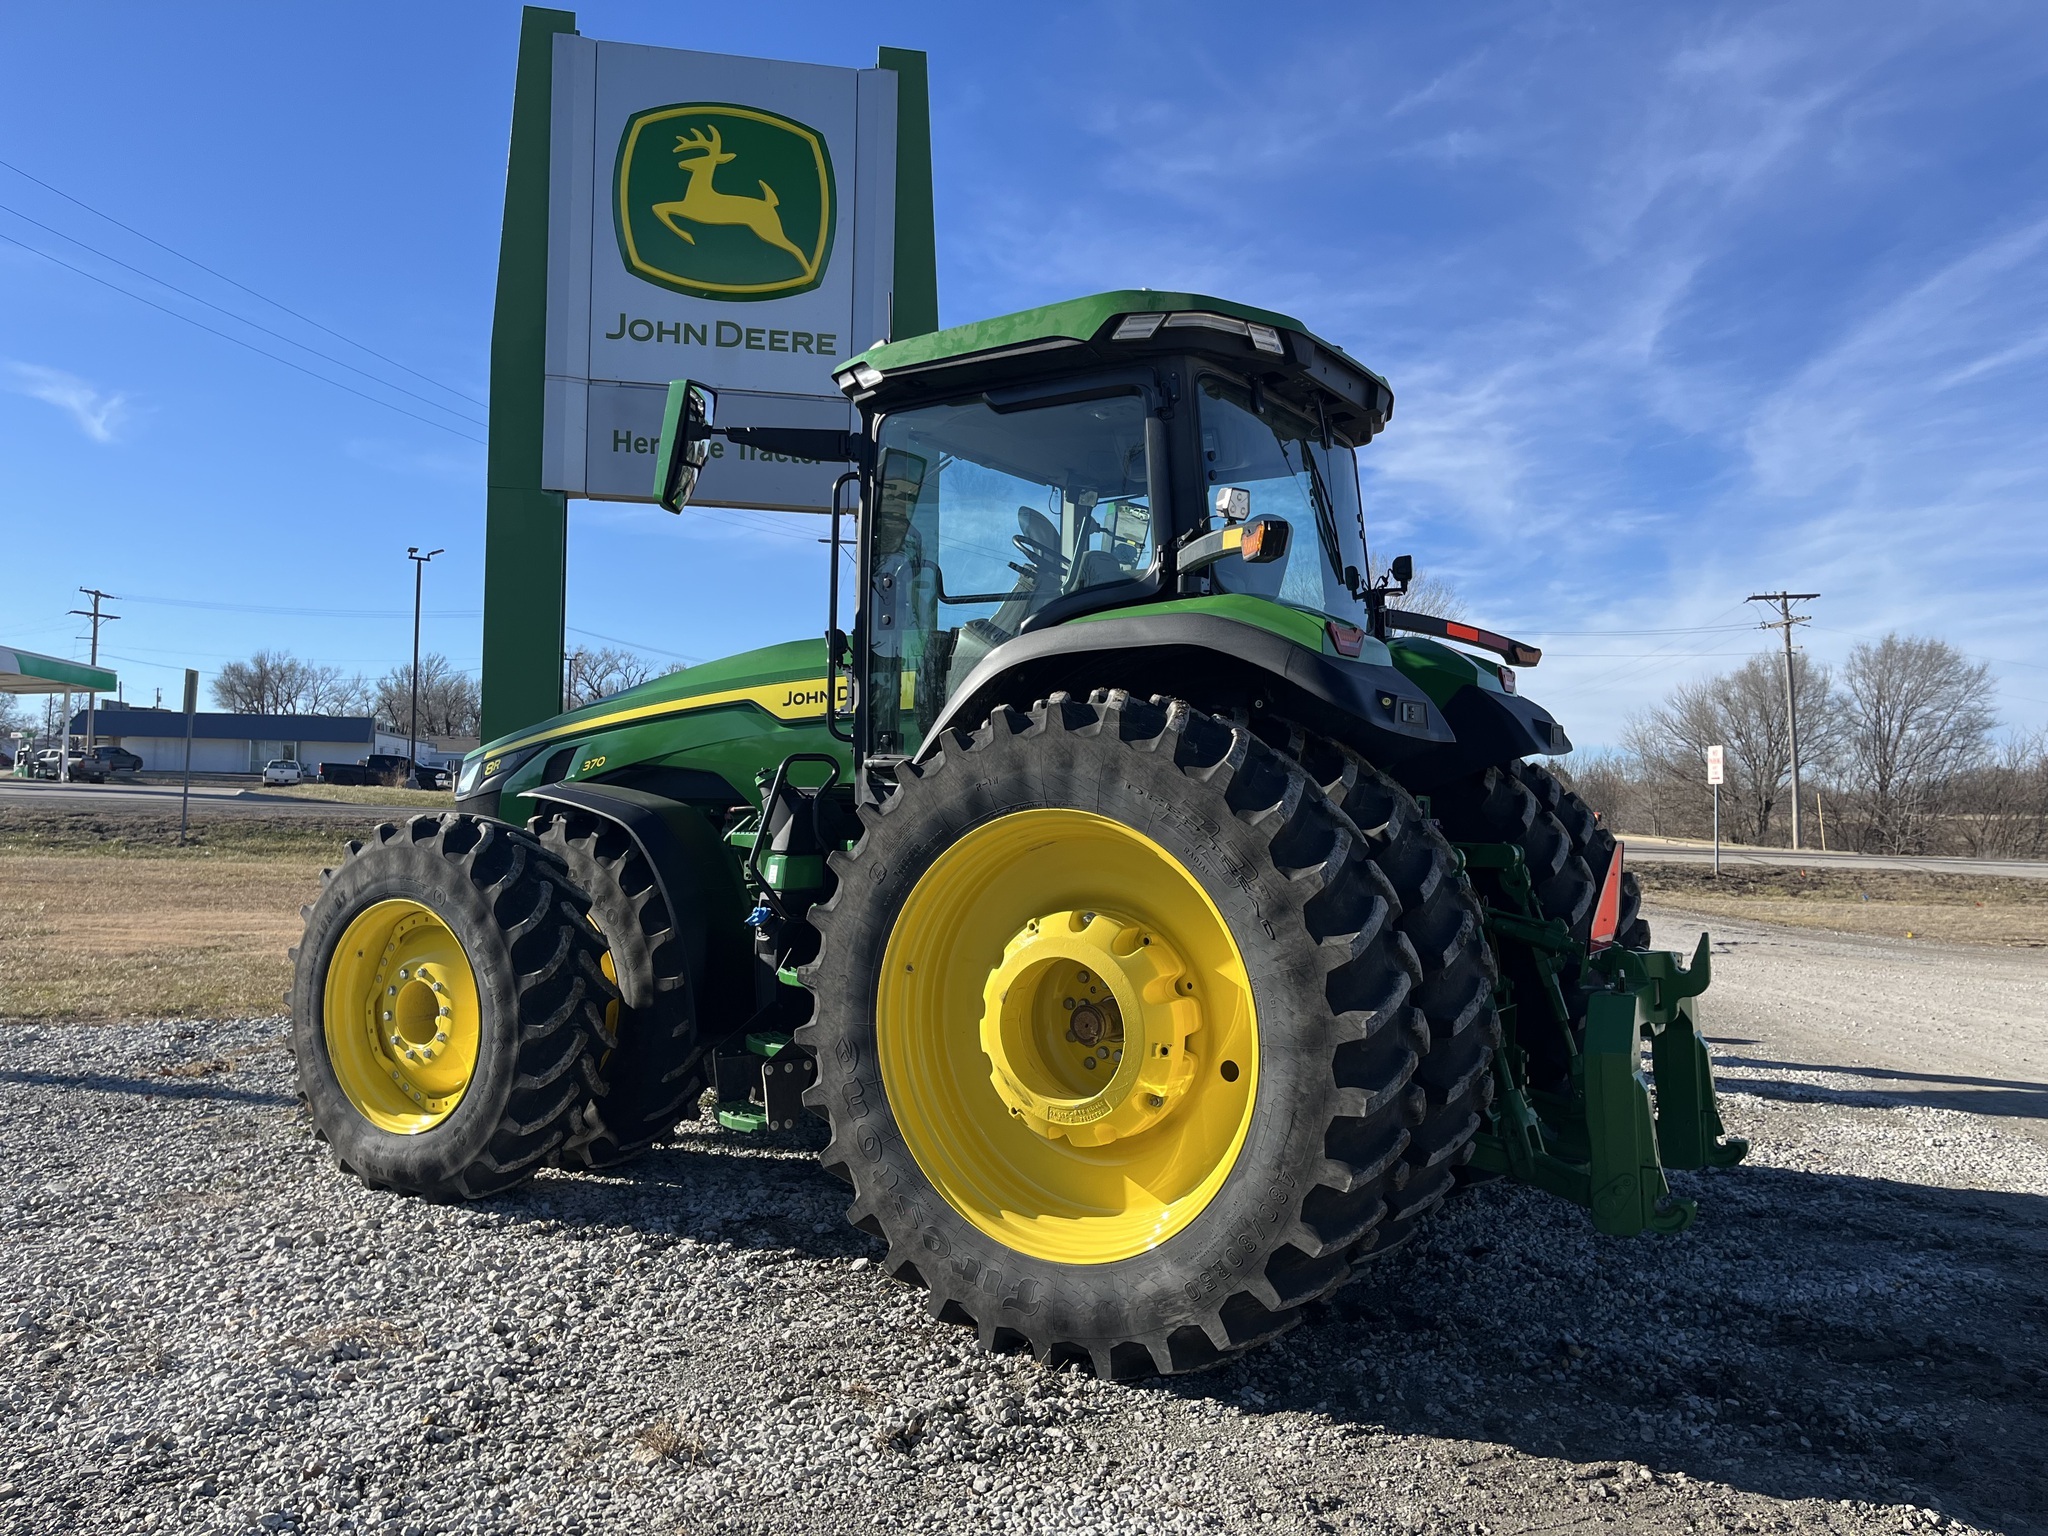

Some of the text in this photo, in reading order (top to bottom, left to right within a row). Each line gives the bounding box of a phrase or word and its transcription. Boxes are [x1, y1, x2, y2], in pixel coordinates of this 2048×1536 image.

[605, 312, 837, 356] JOHN DEERE
[613, 429, 821, 465] Here Trac
[782, 690, 828, 707] JOHN
[484, 759, 502, 776] 8R
[582, 756, 606, 772] 370
[1183, 846, 1210, 876] RADIAL
[567, 868, 639, 973] estone
[834, 1037, 1042, 1317] Firestone
[1183, 1171, 1296, 1302] 480/80R50
